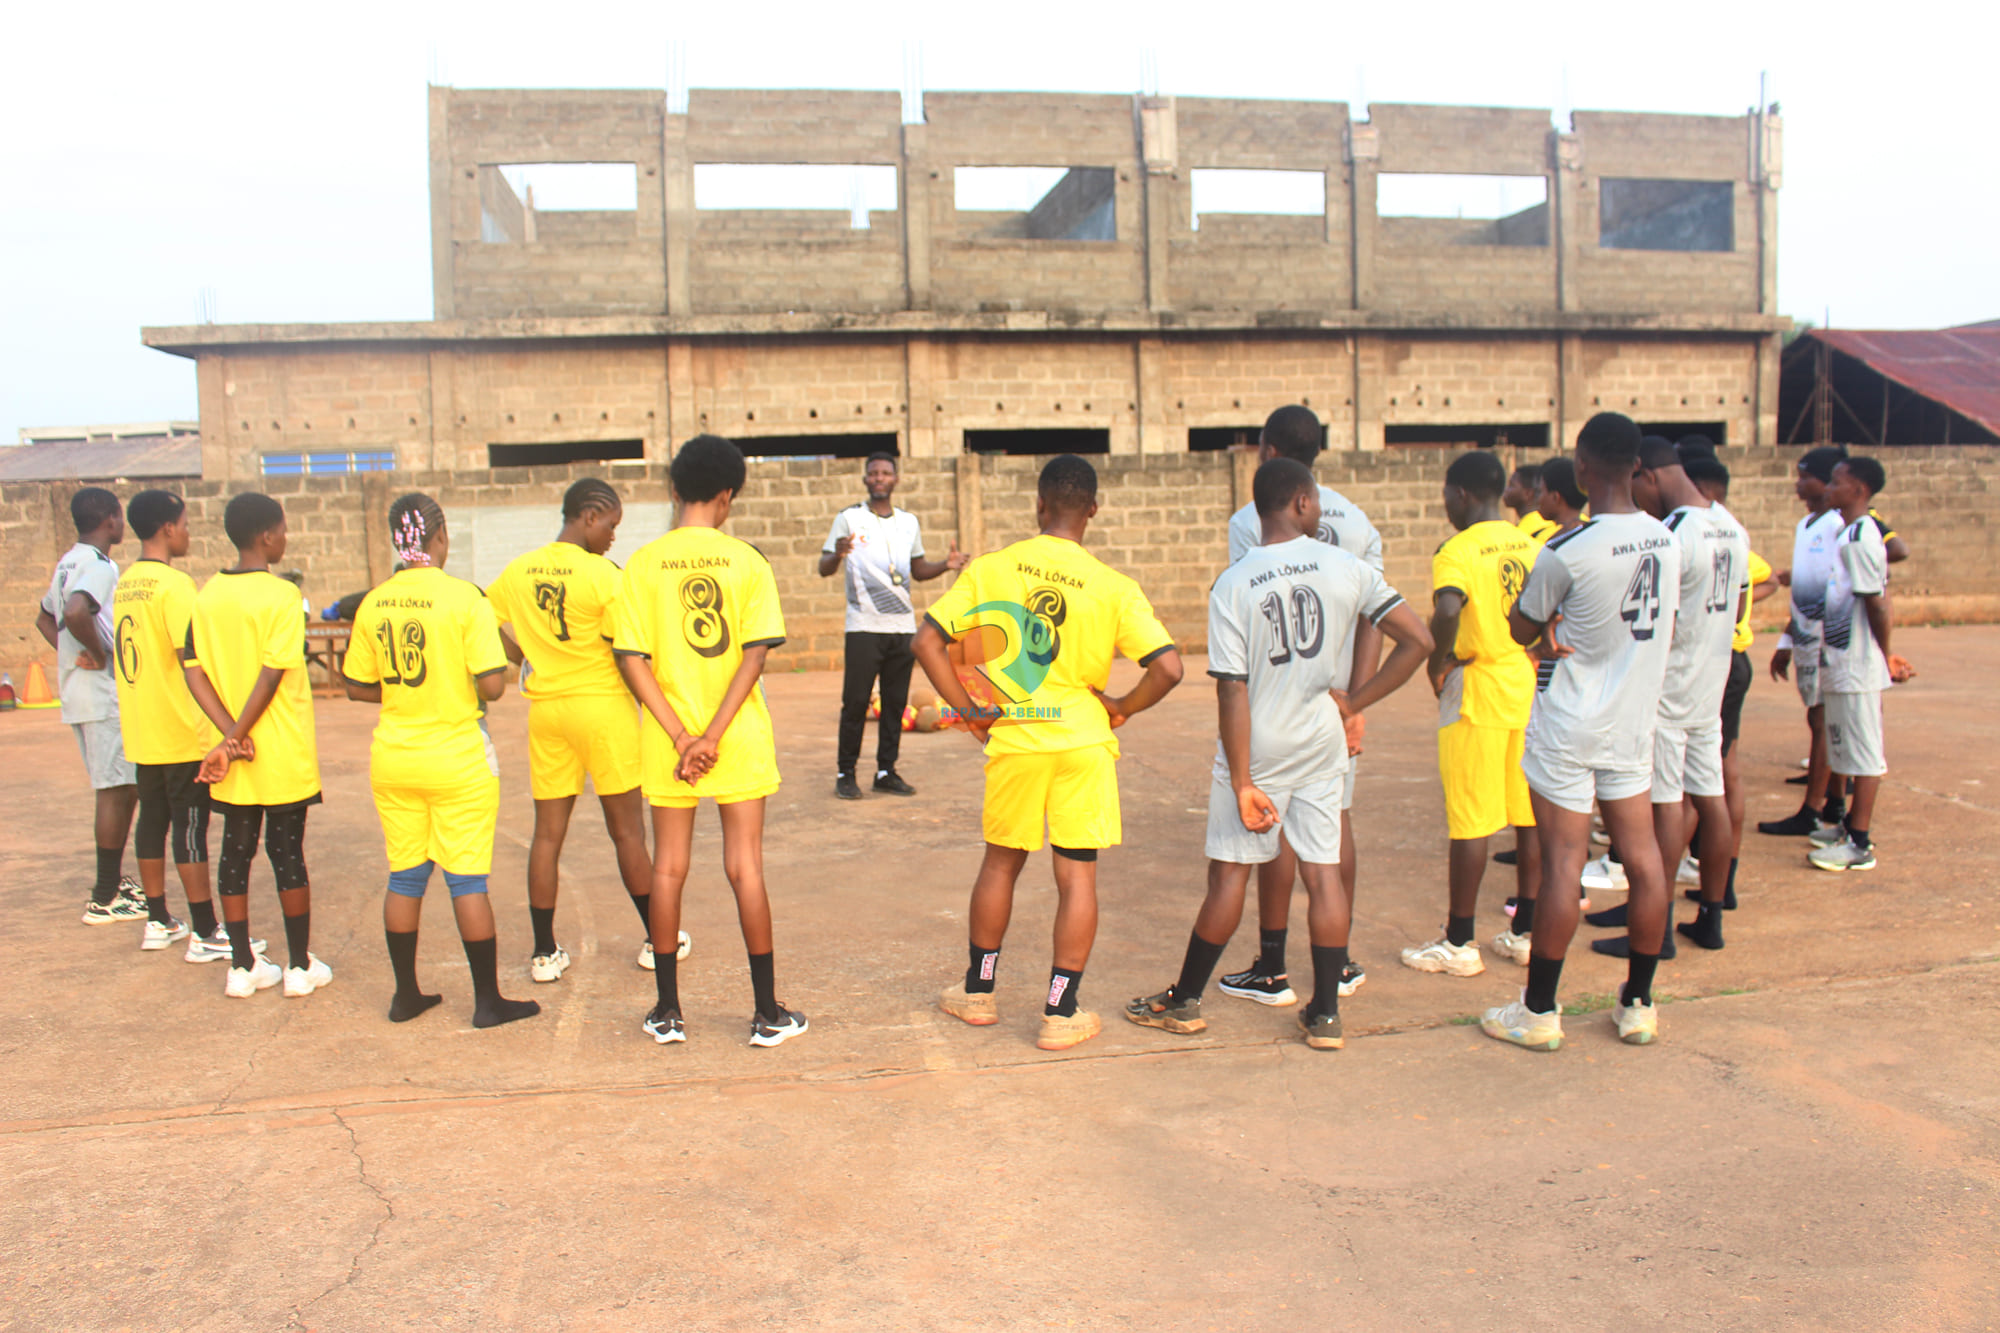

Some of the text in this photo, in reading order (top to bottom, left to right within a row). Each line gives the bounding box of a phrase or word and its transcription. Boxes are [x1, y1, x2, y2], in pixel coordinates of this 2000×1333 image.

[660, 559, 688, 570] AWA
[1612, 543, 1637, 557] AWA
[526, 567, 544, 576] AWA
[1016, 562, 1041, 579] AWA
[1249, 570, 1277, 588] AWA
[375, 598, 397, 608] AWA
[533, 579, 571, 641] 7
[678, 572, 731, 658] 8
[1620, 553, 1661, 641] 4
[1259, 584, 1325, 666] 10
[114, 614, 142, 688] 6
[376, 617, 427, 688] 16
